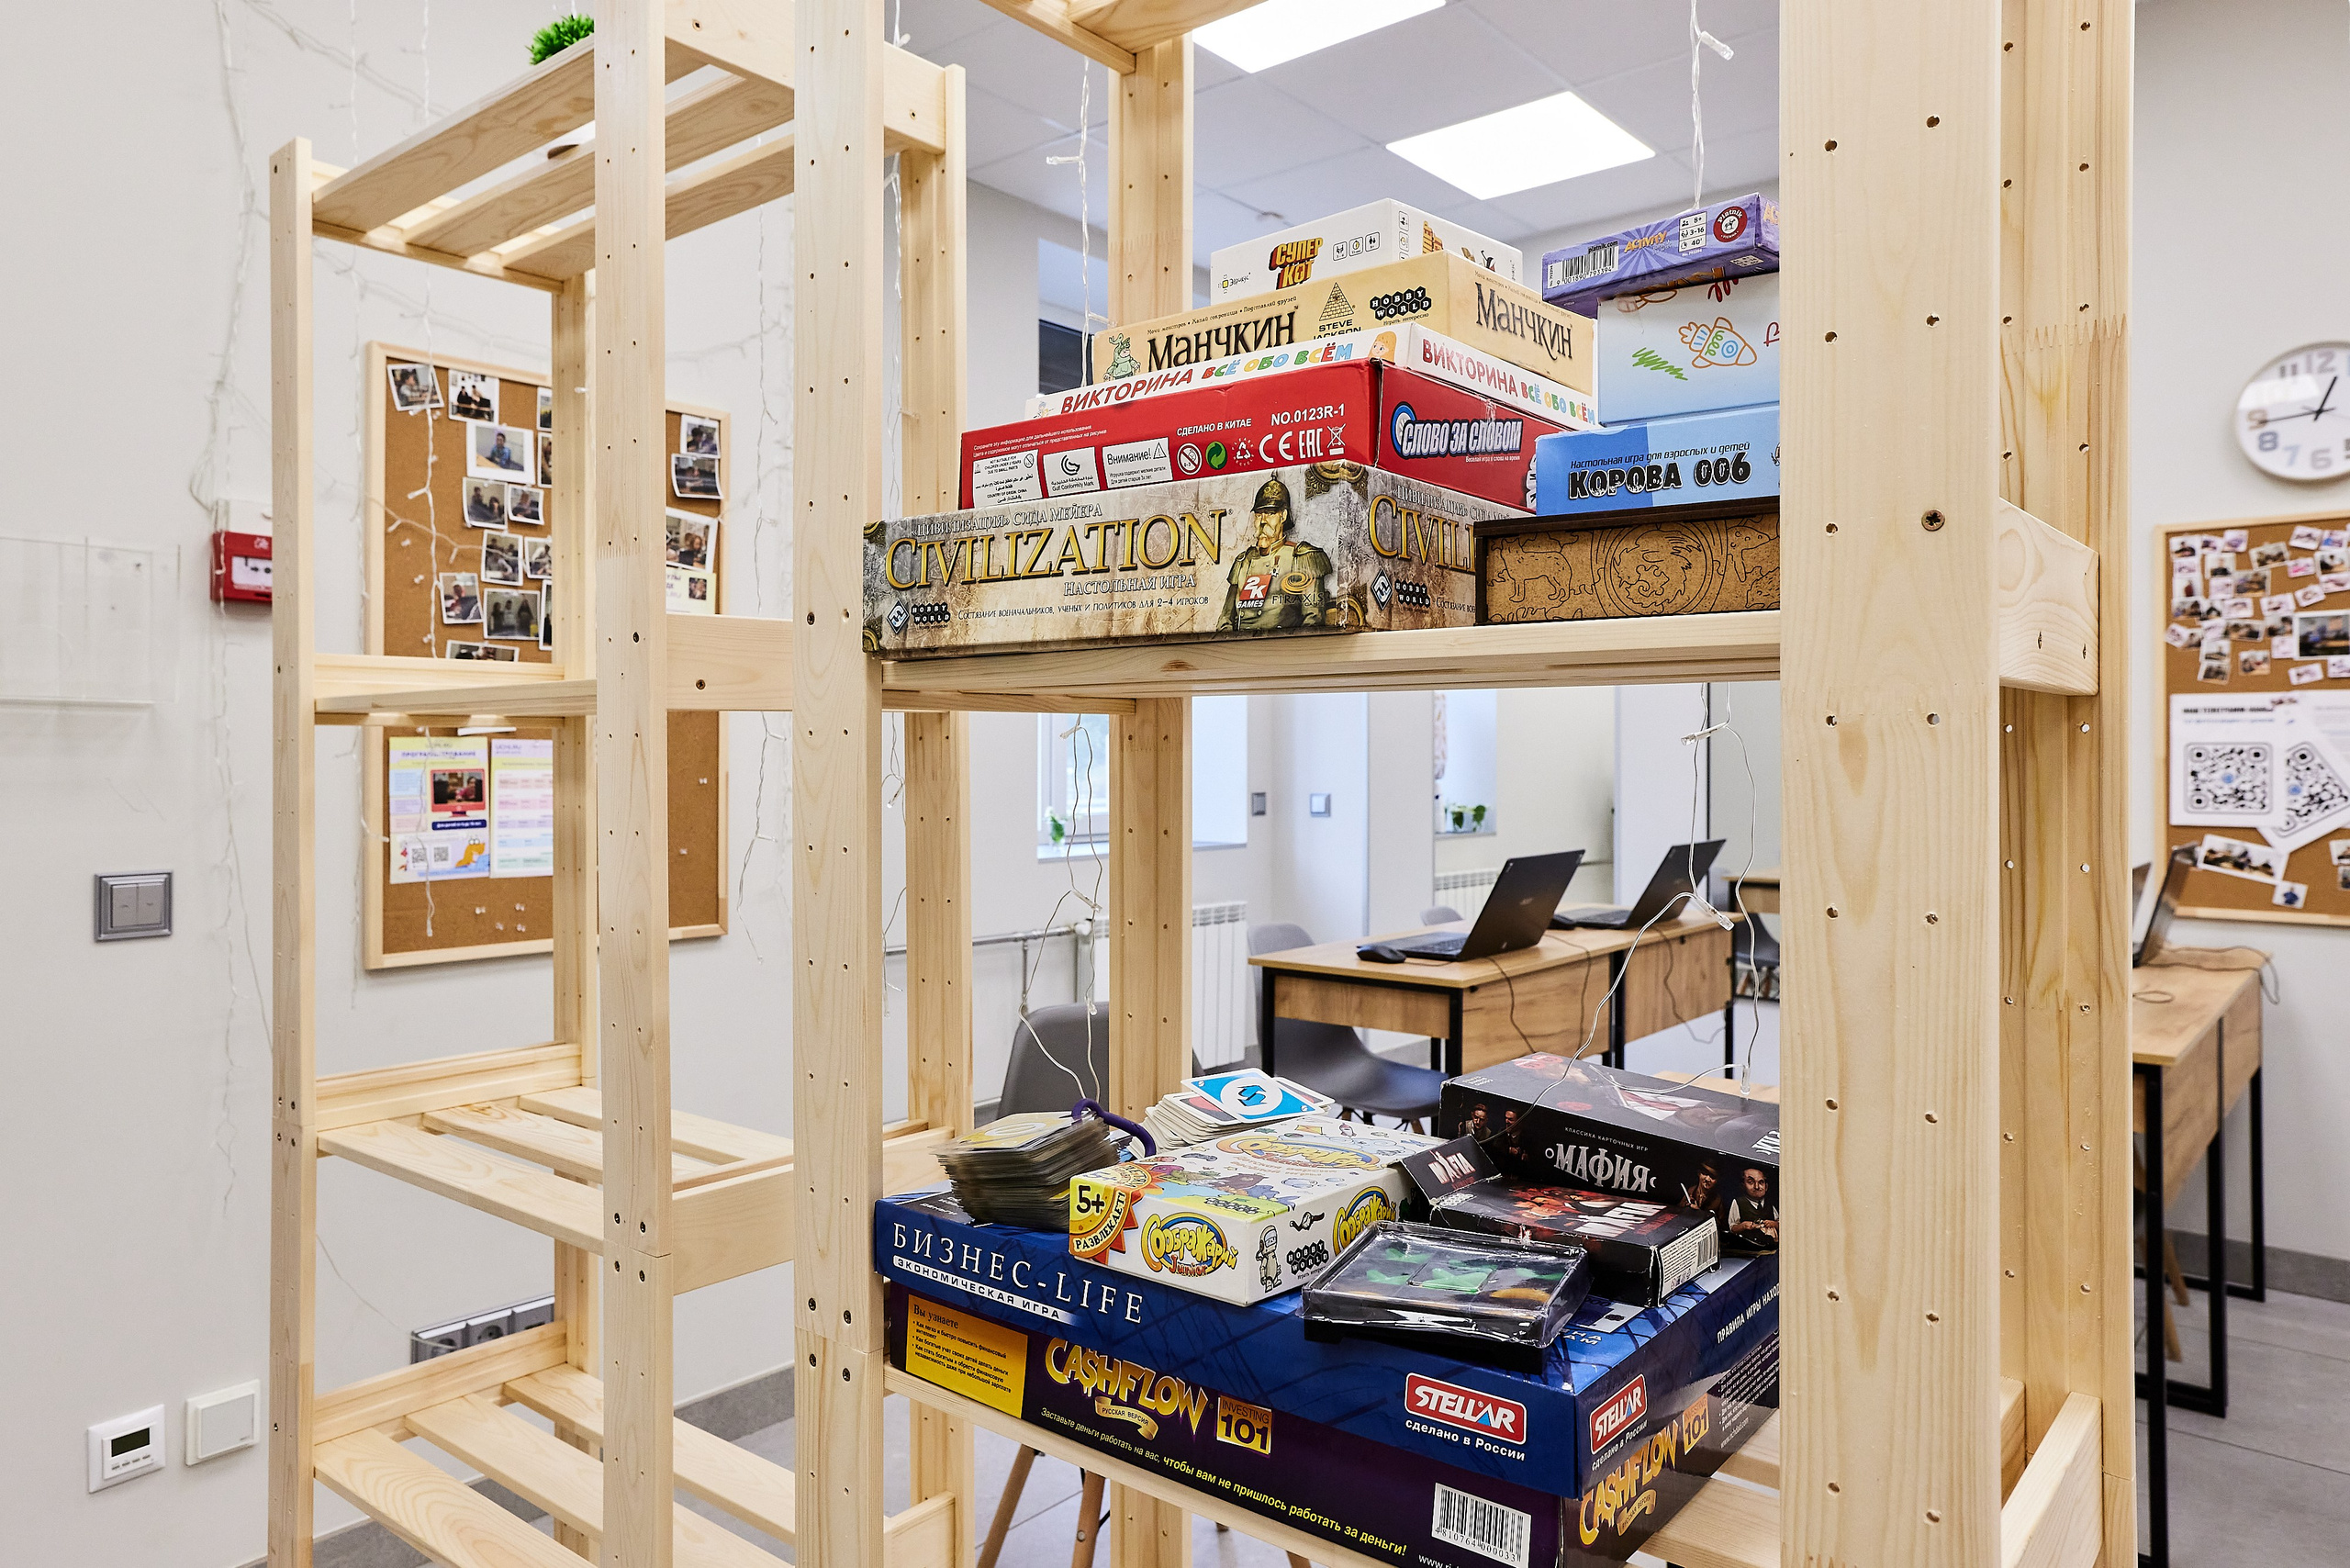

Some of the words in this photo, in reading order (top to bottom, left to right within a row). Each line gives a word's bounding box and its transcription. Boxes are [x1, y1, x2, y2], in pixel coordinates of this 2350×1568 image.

[1624, 230, 1668, 253] ACTIVITY
[1689, 227, 1705, 236] 3-16
[1270, 238, 1323, 269] СУПЕР
[1277, 260, 1315, 289] КОТ
[1563, 274, 1587, 285] 001890
[1589, 267, 1613, 277] 793394
[1371, 287, 1425, 309] HOBBY
[1376, 298, 1430, 319] WORLD
[1318, 319, 1353, 332] STEVE
[1061, 368, 1193, 414] ВИКТОРИНА
[1202, 358, 1240, 380] ВСЁ
[1244, 353, 1289, 373] ОБО
[1293, 342, 1353, 365] ВСЁМ
[1422, 338, 1517, 398] ВИКТОРИНА
[1521, 381, 1542, 405] ВСЁ
[1544, 391, 1567, 414] ОБО
[1570, 400, 1595, 426] ВСЁМ
[1176, 422, 1215, 437] СДЕЛАНО
[1217, 421, 1224, 431] В
[1225, 418, 1252, 430] КИТАЕ
[1270, 403, 1345, 427] NO.0123R-1
[1259, 431, 1294, 464] CE
[1402, 421, 1449, 456] СЛОВО
[1449, 420, 1468, 454] ЗА
[1469, 420, 1522, 453] СЛОВОМ
[2258, 431, 2279, 453] 8
[1107, 447, 1152, 465] Внимание!
[1571, 455, 1623, 469] Настольная
[1624, 454, 1644, 465] игра
[1646, 451, 1662, 462] для
[1663, 447, 1708, 460] взрослых
[1710, 445, 1717, 455] и
[1718, 442, 1751, 455] детей
[1568, 461, 1683, 500] КОРОВА
[1695, 452, 1751, 487] 006
[1013, 510, 1047, 527] СИДА
[1049, 504, 1102, 521] МЕЙЕРА
[1369, 494, 1476, 576] CIVILI
[885, 509, 1227, 590] CIVILIZATION
[1063, 575, 1157, 596] НАСТОЛЬНАЯ
[1159, 574, 1196, 589] ИГРА
[1244, 576, 1266, 599] 2K
[1395, 579, 1427, 594] HOBBY
[912, 602, 947, 615] HOBBY
[1237, 599, 1265, 609] GAMES
[1271, 593, 1324, 606] FIRAXIS
[1398, 592, 1430, 608] WORLD
[914, 612, 950, 624] WORLD
[1564, 1126, 1596, 1139] КЛАССИКА
[1597, 1135, 1635, 1150] КАРТОЧНЫХ
[1636, 1145, 1650, 1153] ИГР
[1553, 1143, 1651, 1193] МАФИЯ
[1076, 1184, 1105, 1214] 5+
[1076, 1192, 1126, 1249] РАЗВЛЕКАЕТ!
[1287, 1240, 1326, 1263] HOBBY
[1292, 1251, 1329, 1273] WORLD
[893, 1222, 1144, 1324] БИЗНЕС-LIFE
[1169, 1255, 1207, 1276] Junior
[898, 1259, 1014, 1305] ЭКОНОМИЧЕСКАЯ
[1022, 1300, 1060, 1320] ИГРА
[913, 1304, 925, 1317] Вы
[928, 1313, 958, 1329] узнаете
[1717, 1313, 1745, 1344] ПРАВИЛА
[1746, 1299, 1762, 1320] ИГРЫ
[925, 1324, 936, 1333] легко
[941, 1328, 957, 1340] быстро
[957, 1336, 979, 1349] повысить
[979, 1343, 1007, 1360] финансовый
[915, 1344, 923, 1352] Как
[923, 1348, 934, 1357] стать
[935, 1351, 954, 1363] богатым
[957, 1360, 976, 1372] обрести
[976, 1367, 1004, 1383] финансовую
[915, 1350, 946, 1367] независимость
[946, 1363, 957, 1372] даже
[967, 1372, 990, 1384] небольшой
[924, 1338, 941, 1350] богатые
[965, 1354, 978, 1364] детей
[978, 1359, 992, 1370] делать
[993, 1365, 1009, 1376] деньги
[1102, 1406, 1125, 1417] РУССКАЯ
[1127, 1411, 1149, 1426] ВЕРСИЯ
[1221, 1398, 1270, 1424] INVESTING
[1414, 1384, 1516, 1434] STELLAR
[1595, 1385, 1643, 1442] STELLAR
[1221, 1414, 1269, 1450] 101
[1684, 1409, 1708, 1442] 101
[1405, 1419, 1460, 1442] сделано
[1463, 1435, 1471, 1446] в
[1475, 1439, 1526, 1462] России
[1591, 1445, 1618, 1472] сделано
[1040, 1407, 1075, 1428] Заставьте
[1075, 1420, 1100, 1438] деньги
[1100, 1429, 1133, 1451] работать
[1134, 1444, 1144, 1456] на
[1145, 1449, 1160, 1463] вас,
[1163, 1454, 1194, 1475] чтобы
[1196, 1469, 1217, 1484] вам
[1218, 1477, 1231, 1490] не
[1233, 1483, 1287, 1511] пришлось
[1289, 1505, 1342, 1533] работать
[1343, 1525, 1359, 1540] за
[1359, 1529, 1407, 1557] деньги!
[1441, 1529, 1476, 1548] 810764
[1481, 1542, 1516, 1562] 000033
